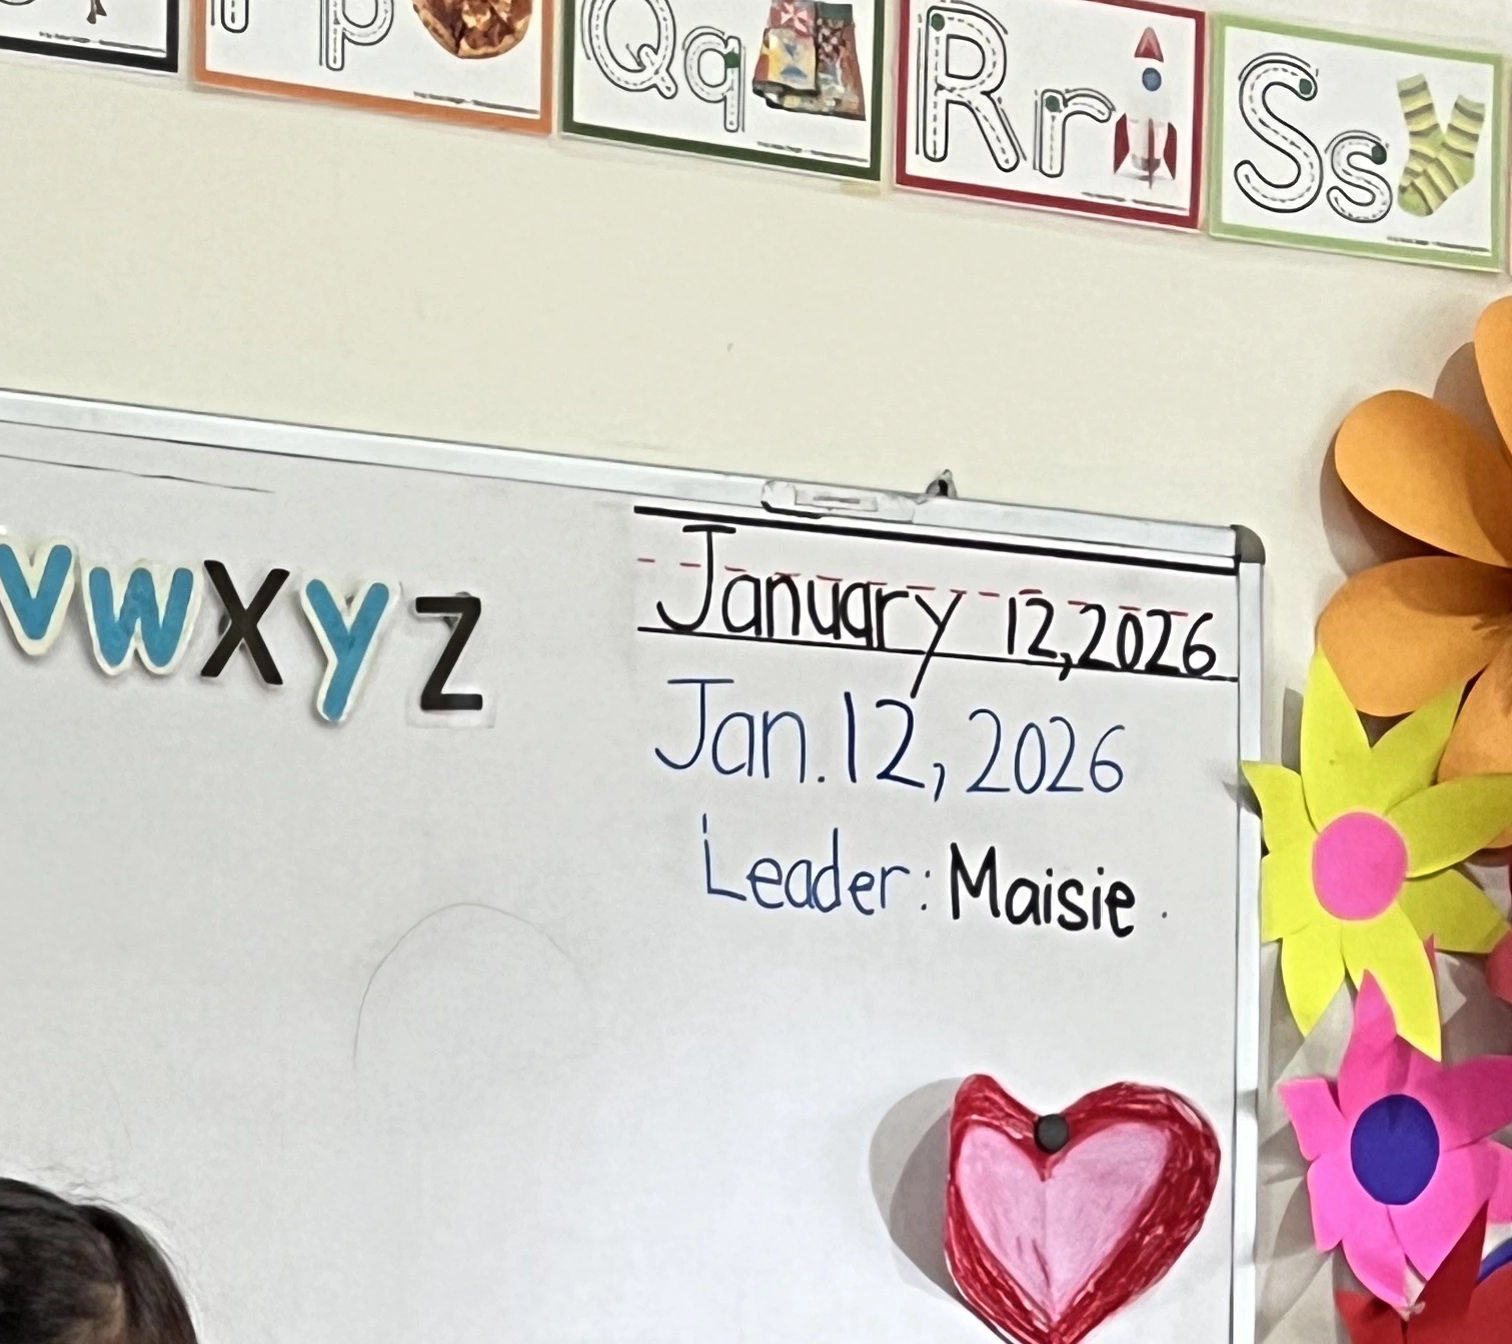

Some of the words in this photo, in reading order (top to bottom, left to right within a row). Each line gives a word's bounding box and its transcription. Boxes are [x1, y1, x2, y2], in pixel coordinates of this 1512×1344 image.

[588, 0, 741, 132] Qq
[923, 6, 1112, 177] Rr
[1234, 59, 1393, 223] Ss
[656, 525, 964, 698] January
[701, 813, 931, 915] Leader:
[950, 841, 1137, 937] Maisie
